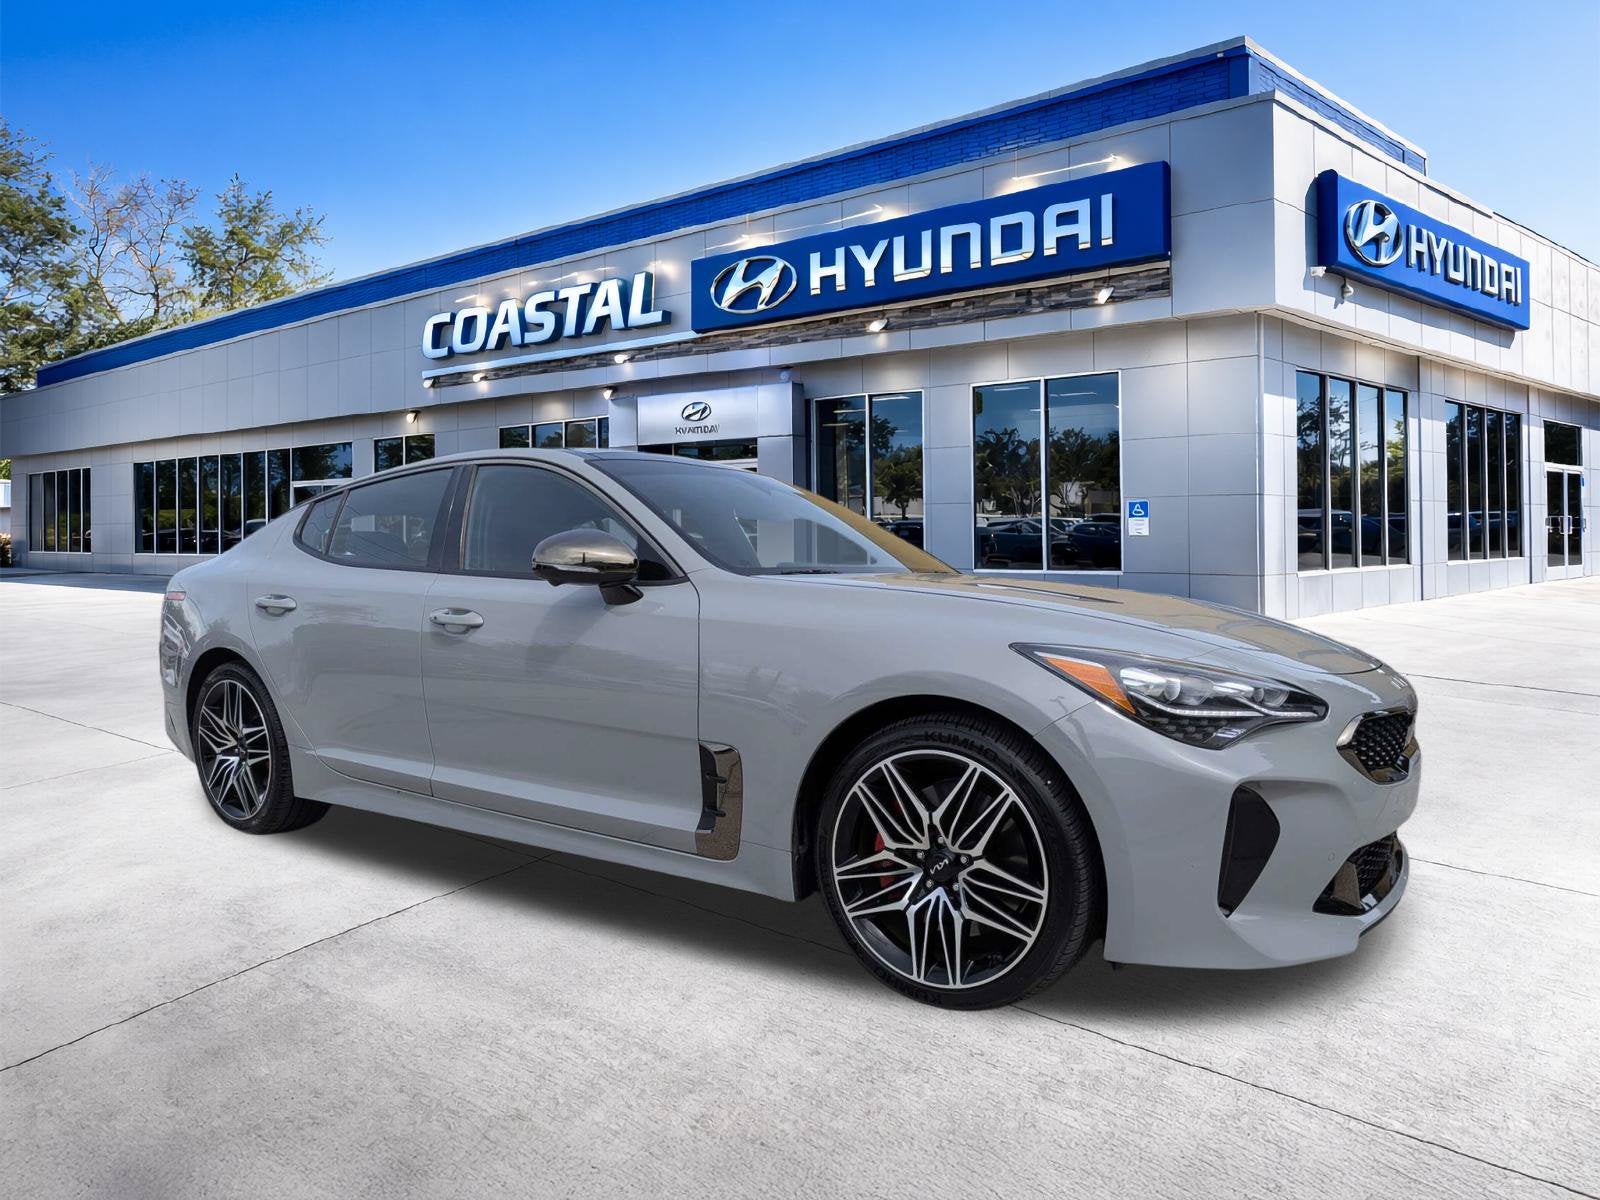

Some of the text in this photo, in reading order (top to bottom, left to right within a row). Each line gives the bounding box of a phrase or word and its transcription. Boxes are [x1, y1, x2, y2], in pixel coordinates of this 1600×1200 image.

[809, 193, 1114, 295] HYUNDAI
[1407, 225, 1521, 306] HYUNDAI
[422, 271, 667, 359] COASTAL
